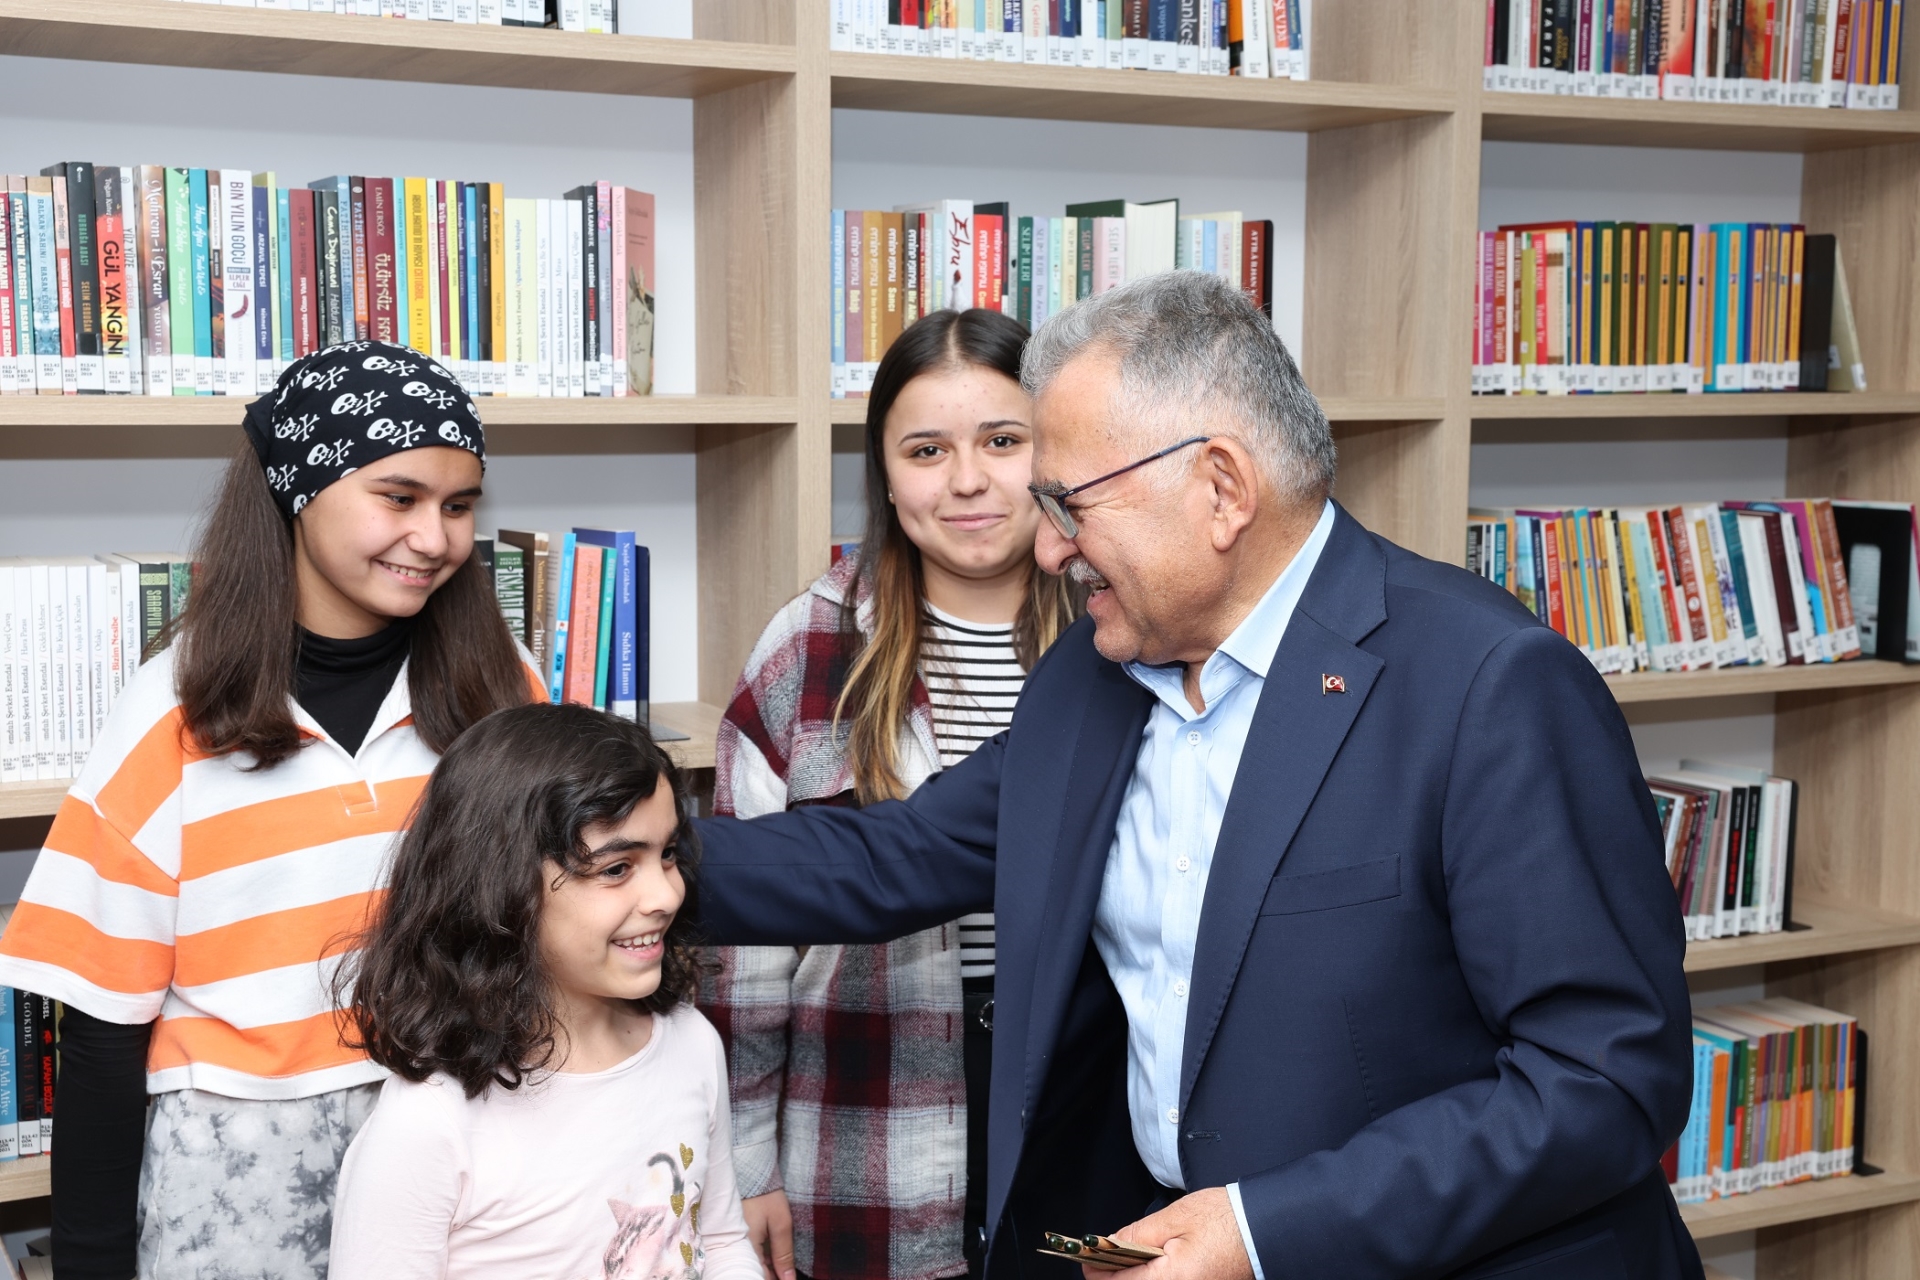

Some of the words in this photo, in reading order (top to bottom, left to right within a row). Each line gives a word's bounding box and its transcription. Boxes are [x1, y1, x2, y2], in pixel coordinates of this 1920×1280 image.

[230, 181, 244, 200] BİN
[375, 187, 385, 208] EMİN
[38, 199, 46, 230] BALKAN
[231, 204, 245, 232] YILIN
[354, 202, 362, 244] FATİH'İN
[124, 228, 134, 246] YÜZ
[231, 235, 246, 264] GÖÇÜ
[258, 233, 266, 263] ARZAVUL
[949, 212, 971, 266] Ebru
[104, 241, 121, 278] GÜL
[125, 247, 134, 268] YÜZE
[342, 249, 351, 278] GİZLİ
[356, 246, 364, 274] GİZLİ
[18, 258, 28, 300] KARGISI
[41, 266, 49, 293] HASAN
[259, 265, 267, 287] TEPESİ
[375, 253, 391, 311] ÖLÜMSÜZ
[82, 280, 91, 301] SELİM
[21, 304, 30, 331] HASAN
[83, 302, 92, 333] ERDOĞAN
[106, 283, 123, 355] YANGINI
[154, 306, 162, 337] YUSUF
[330, 293, 340, 325] Haldun
[621, 543, 630, 567] Naşide
[623, 568, 631, 604] Gökbudak
[38, 604, 46, 629] Mehmet
[147, 590, 162, 626] SARAYIN
[111, 617, 119, 645] Nesibe
[111, 647, 119, 671] Bizim
[622, 632, 632, 661] Sıdıka
[21, 665, 29, 693] Esendal
[40, 662, 48, 690] Esendal
[56, 664, 65, 692] Esendal
[75, 663, 83, 691] Esendal
[622, 663, 631, 694] Hanım
[5, 694, 15, 719] Şevket
[22, 695, 31, 719] Şevket
[41, 693, 51, 717] Şevket
[57, 694, 67, 718] Şevket
[76, 693, 85, 717] Şevket
[95, 691, 105, 715] Şevket
[24, 1002, 32, 1047] GÖKDEL
[0, 1047, 9, 1068] Asıl
[43, 1056, 53, 1084] KAFAM
[1, 1069, 10, 1088] Adı
[1, 1089, 11, 1116] Atiye
[44, 1086, 53, 1113] BOZUK
